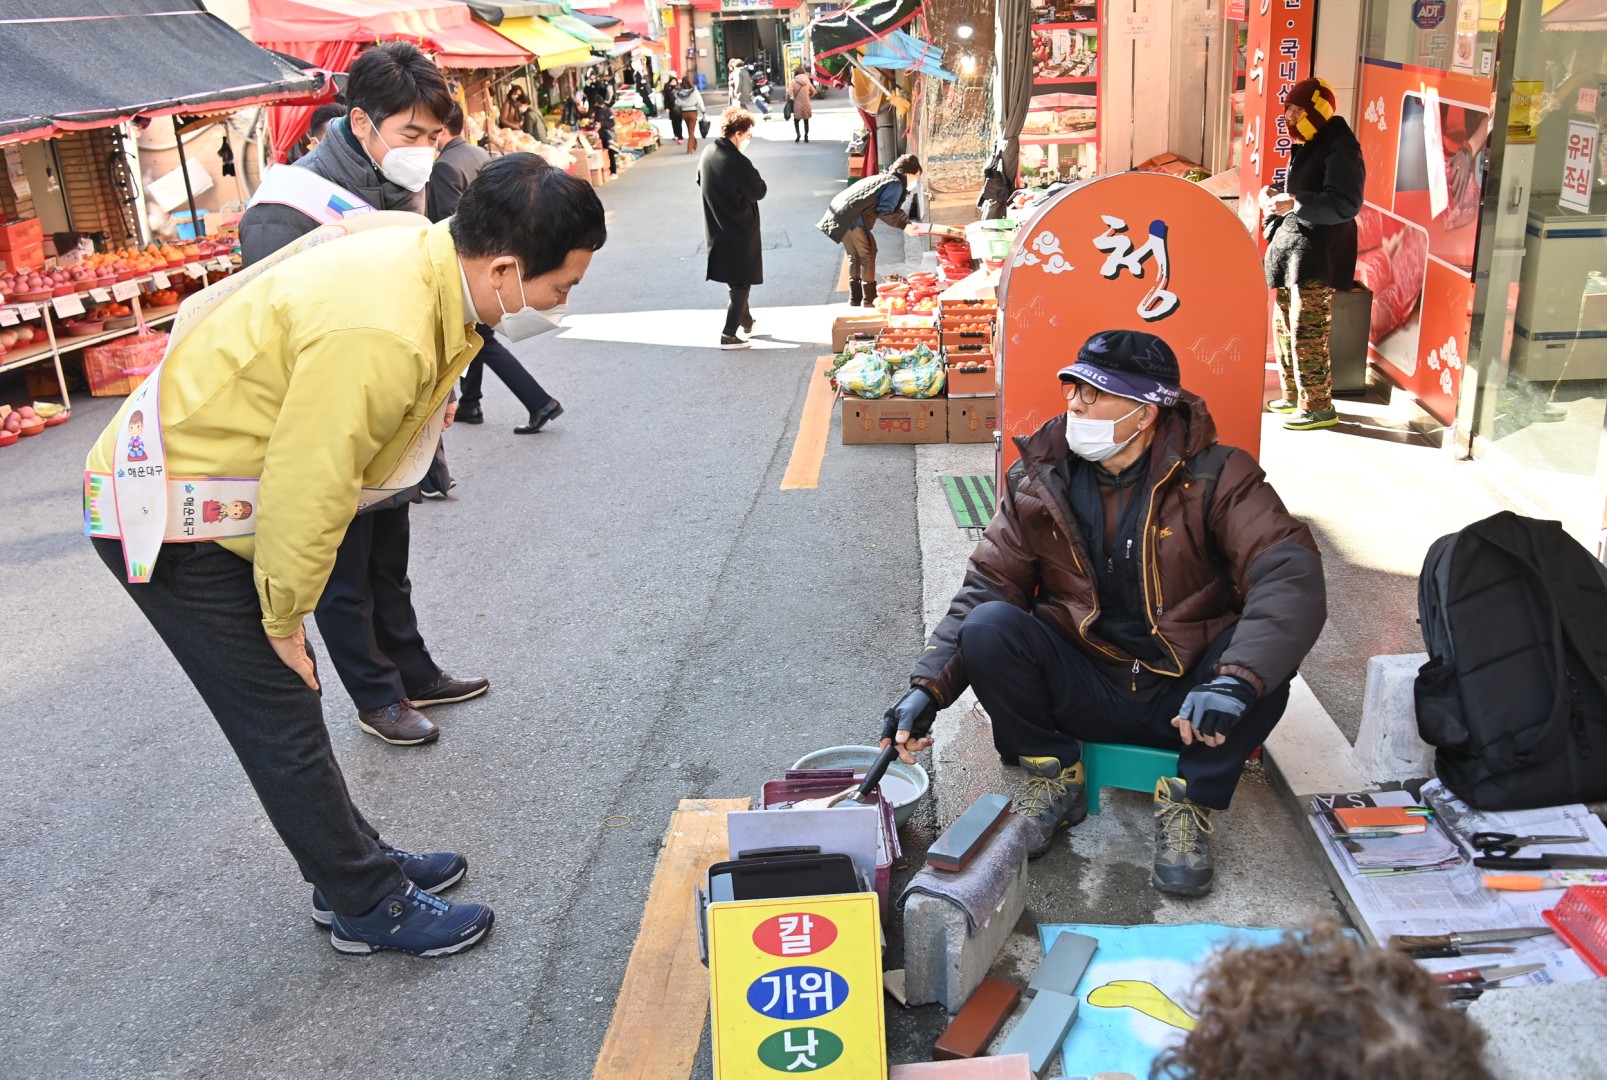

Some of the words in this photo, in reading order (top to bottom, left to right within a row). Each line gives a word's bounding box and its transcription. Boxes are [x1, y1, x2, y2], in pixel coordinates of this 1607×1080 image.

[1417, 5, 1441, 17] ADT
[1567, 134, 1595, 164] 유리
[1563, 166, 1590, 196] 조심
[1092, 214, 1180, 321] 청
[879, 420, 911, 433] Dole
[127, 465, 163, 478] 해운대구
[183, 497, 195, 536] 해운대구
[778, 914, 814, 955] 칼
[761, 971, 834, 1014] 가위
[783, 1029, 819, 1072] 낫
